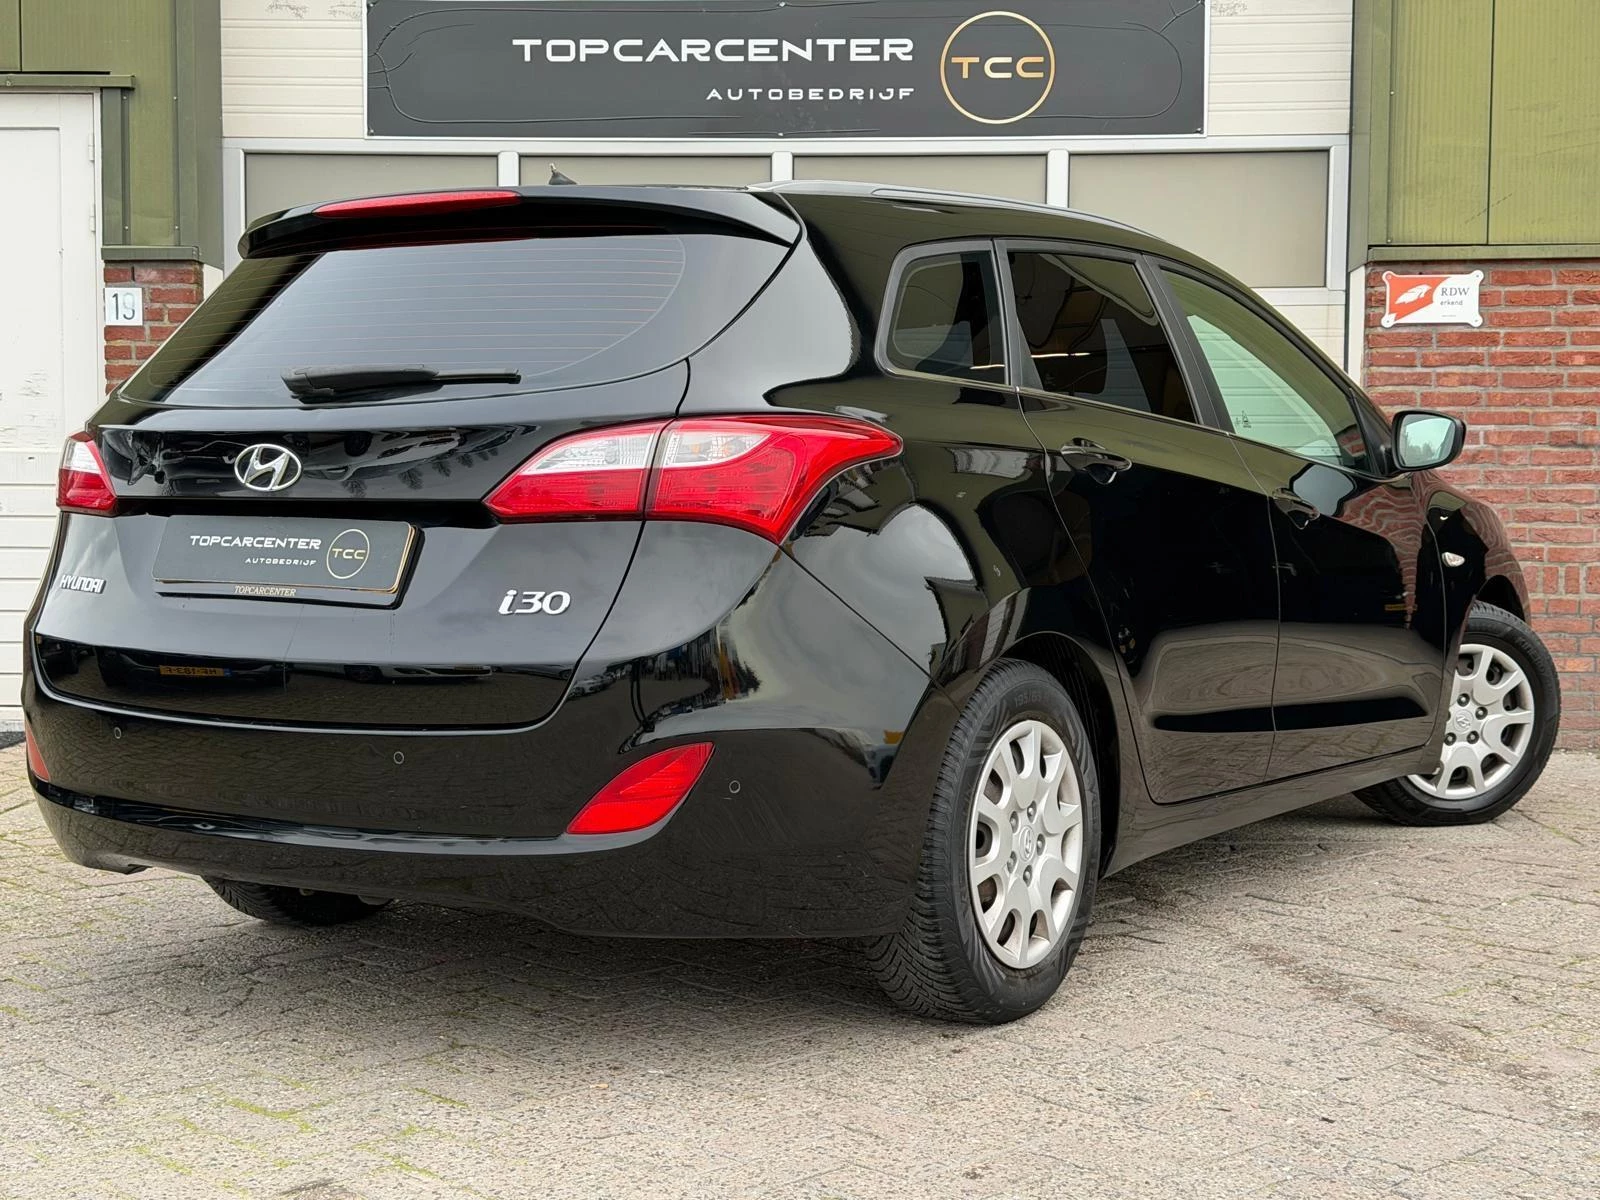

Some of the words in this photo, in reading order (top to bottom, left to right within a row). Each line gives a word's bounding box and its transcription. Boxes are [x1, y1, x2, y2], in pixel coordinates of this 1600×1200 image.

[512, 38, 914, 62] TOPCARCENTER
[951, 56, 1044, 79] TCC
[706, 88, 914, 101] AUTOBEDRIJF
[1441, 287, 1470, 297] RDW
[111, 292, 136, 320] 19
[190, 535, 322, 550] TOPCARCENTER
[245, 557, 317, 566] AUTOBEDRIJF
[331, 548, 366, 560] TCC
[60, 574, 105, 594] HYUNDAI
[234, 585, 297, 597] TOPCARCENTER
[498, 589, 571, 615] i30
